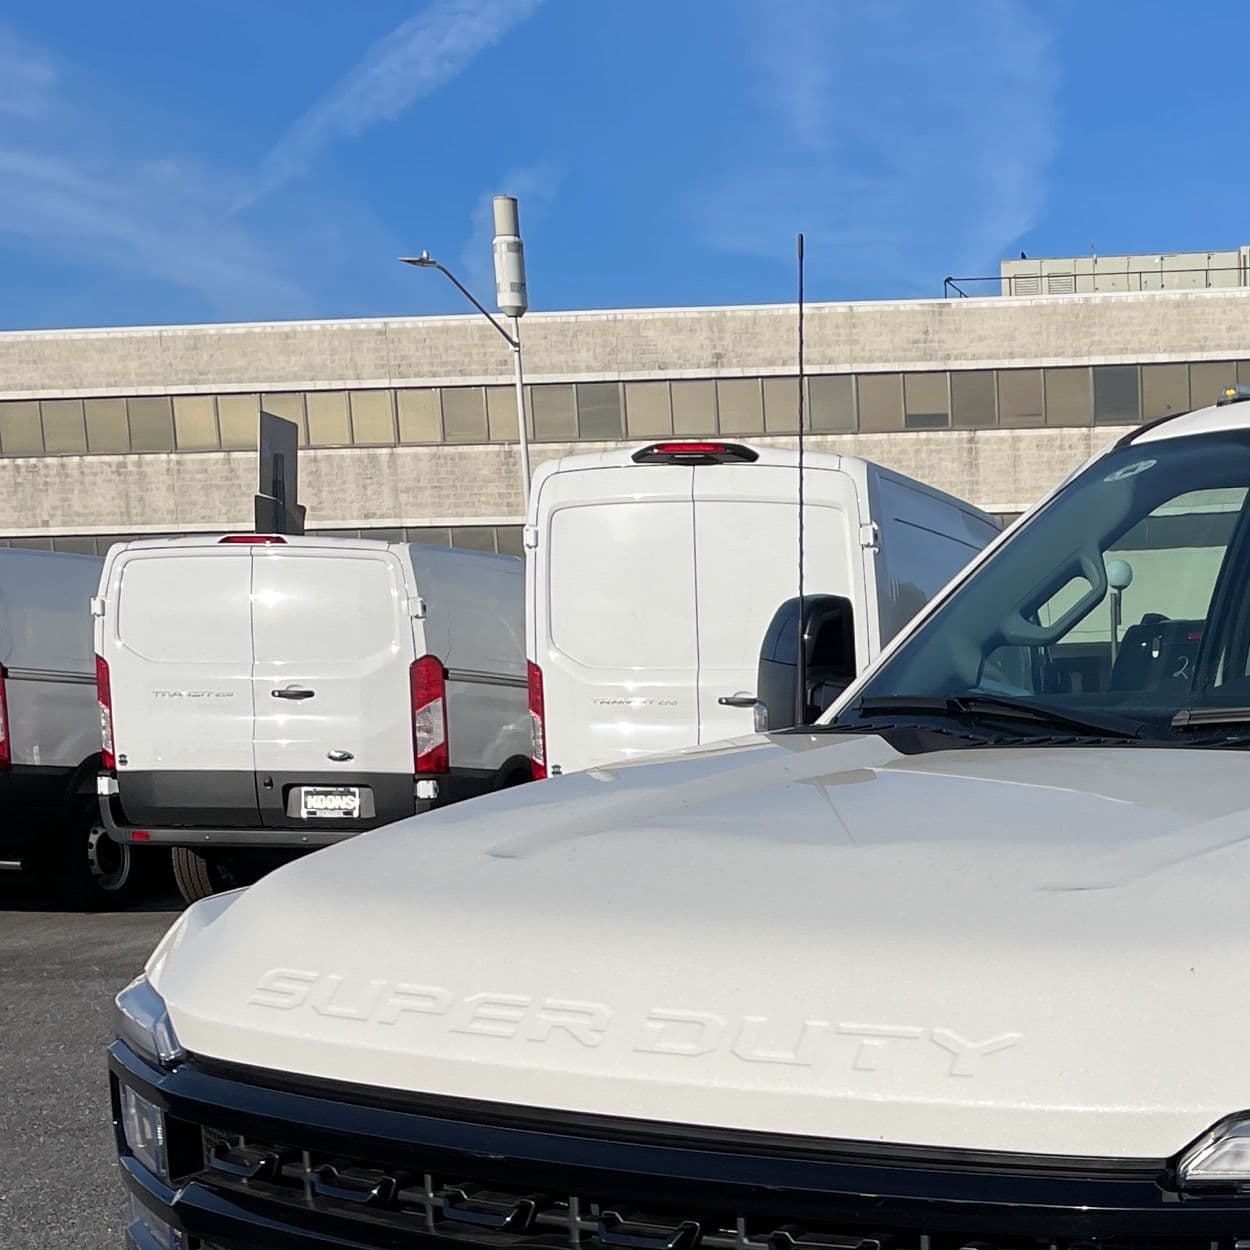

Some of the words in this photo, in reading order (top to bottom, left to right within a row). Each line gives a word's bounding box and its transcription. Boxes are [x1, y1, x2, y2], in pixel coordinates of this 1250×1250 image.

[306, 795, 355, 810] KOONS
[247, 966, 616, 1049] SUPER
[631, 1006, 1025, 1078] DUTY
